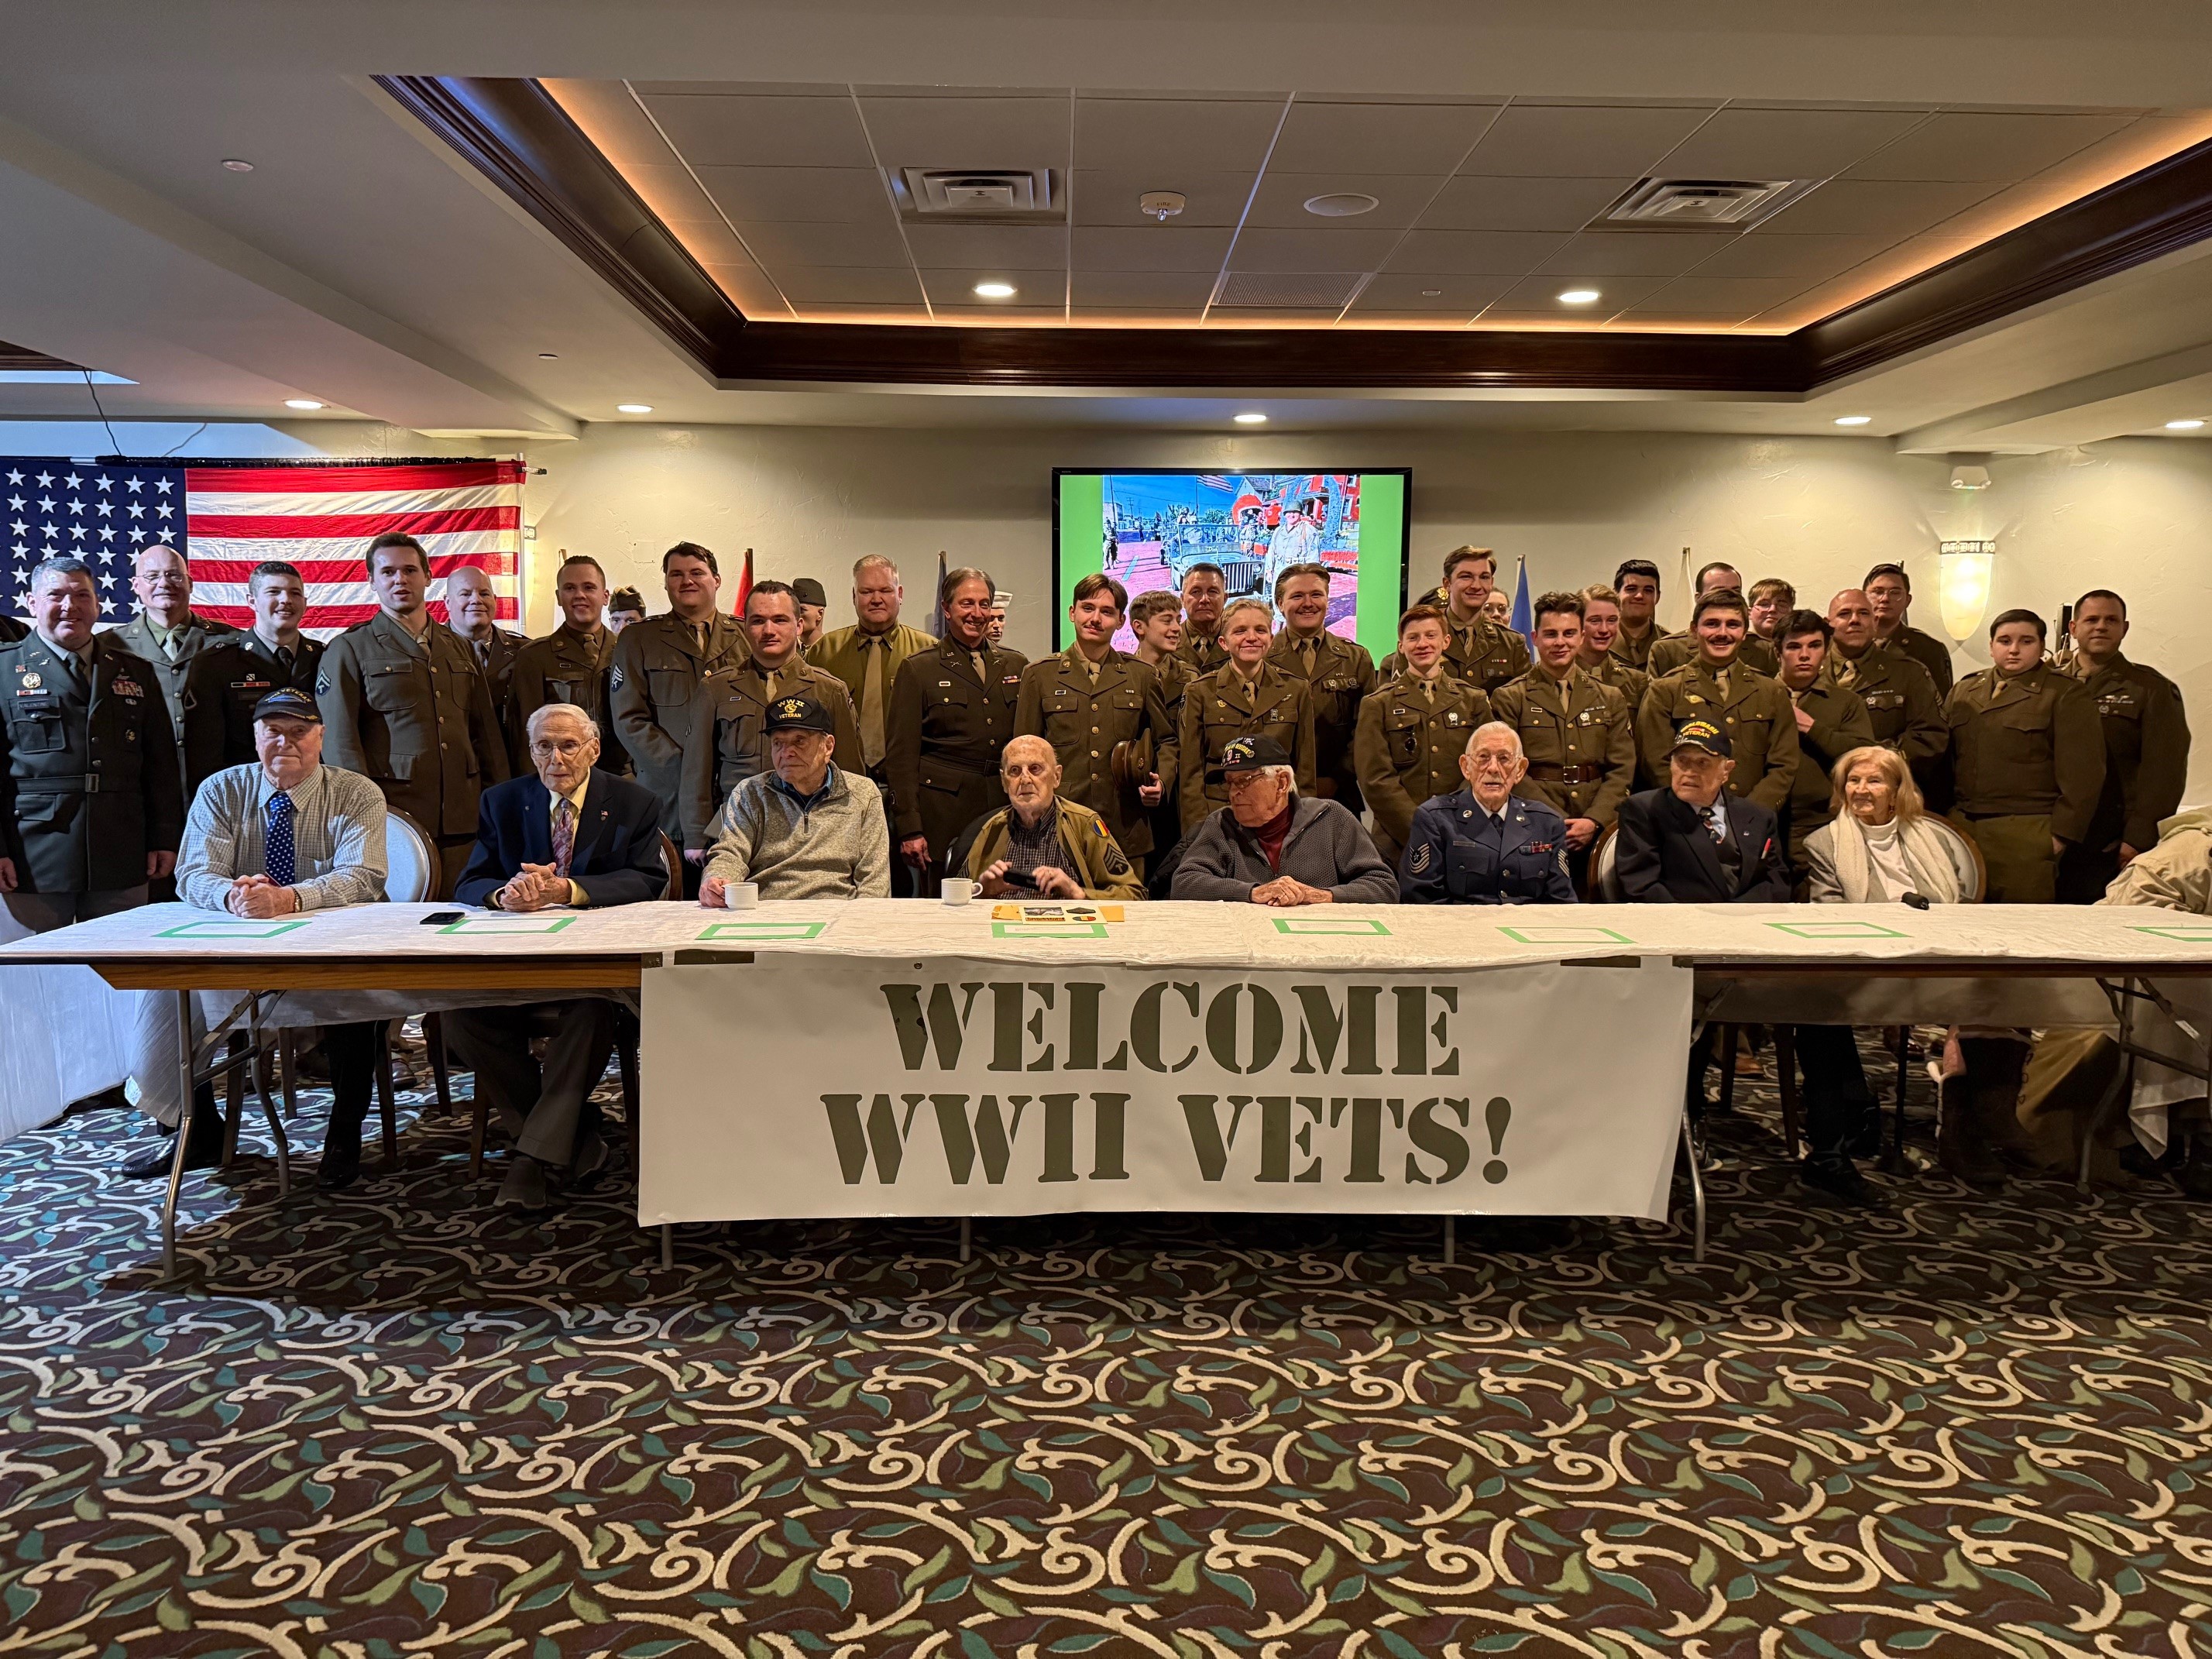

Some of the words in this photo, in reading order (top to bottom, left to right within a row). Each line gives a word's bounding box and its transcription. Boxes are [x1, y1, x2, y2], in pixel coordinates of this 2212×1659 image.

[280, 688, 312, 702] VETERAN
[777, 699, 805, 708] WWII
[880, 982, 1459, 1076] WELCOME
[820, 1093, 1131, 1185] WWII
[1177, 1095, 1512, 1185] VETS!
